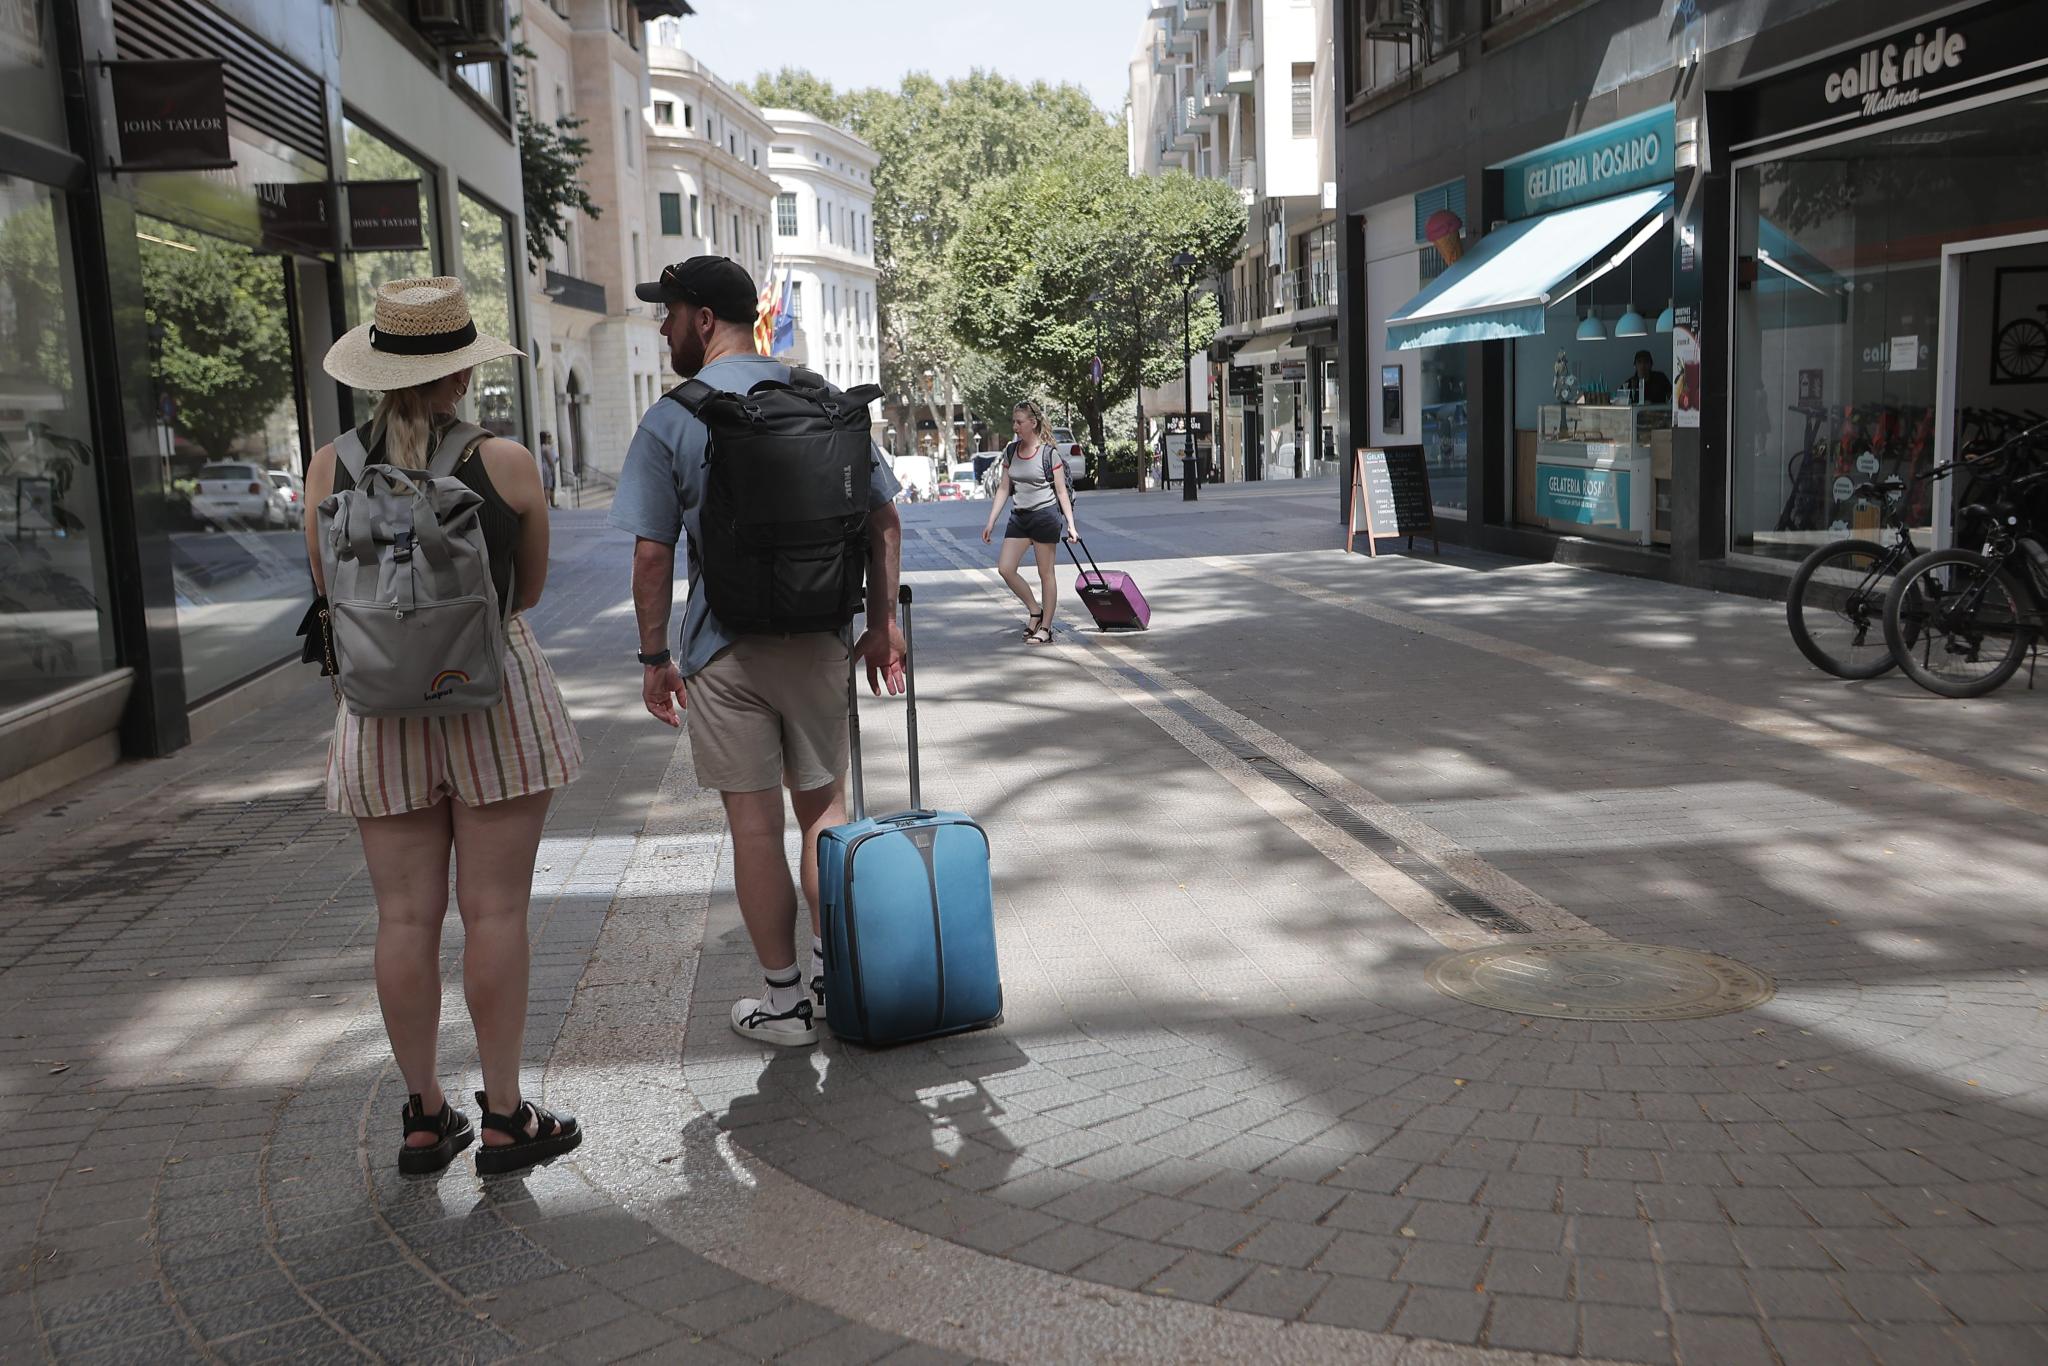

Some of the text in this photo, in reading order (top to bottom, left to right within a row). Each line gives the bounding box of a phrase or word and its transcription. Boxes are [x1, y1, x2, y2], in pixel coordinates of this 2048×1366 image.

[1825, 50, 1879, 103] call
[1903, 27, 1966, 82] ride
[1862, 88, 1920, 117] Mallorca
[123, 117, 222, 133] JOHN TAYLOR
[1528, 133, 1660, 199] GELATERIA ROSARIO
[353, 217, 418, 228] JOHN TAYLOR
[844, 464, 852, 499] THULE
[1549, 476, 1615, 498] GELATERIA ROSARIO
